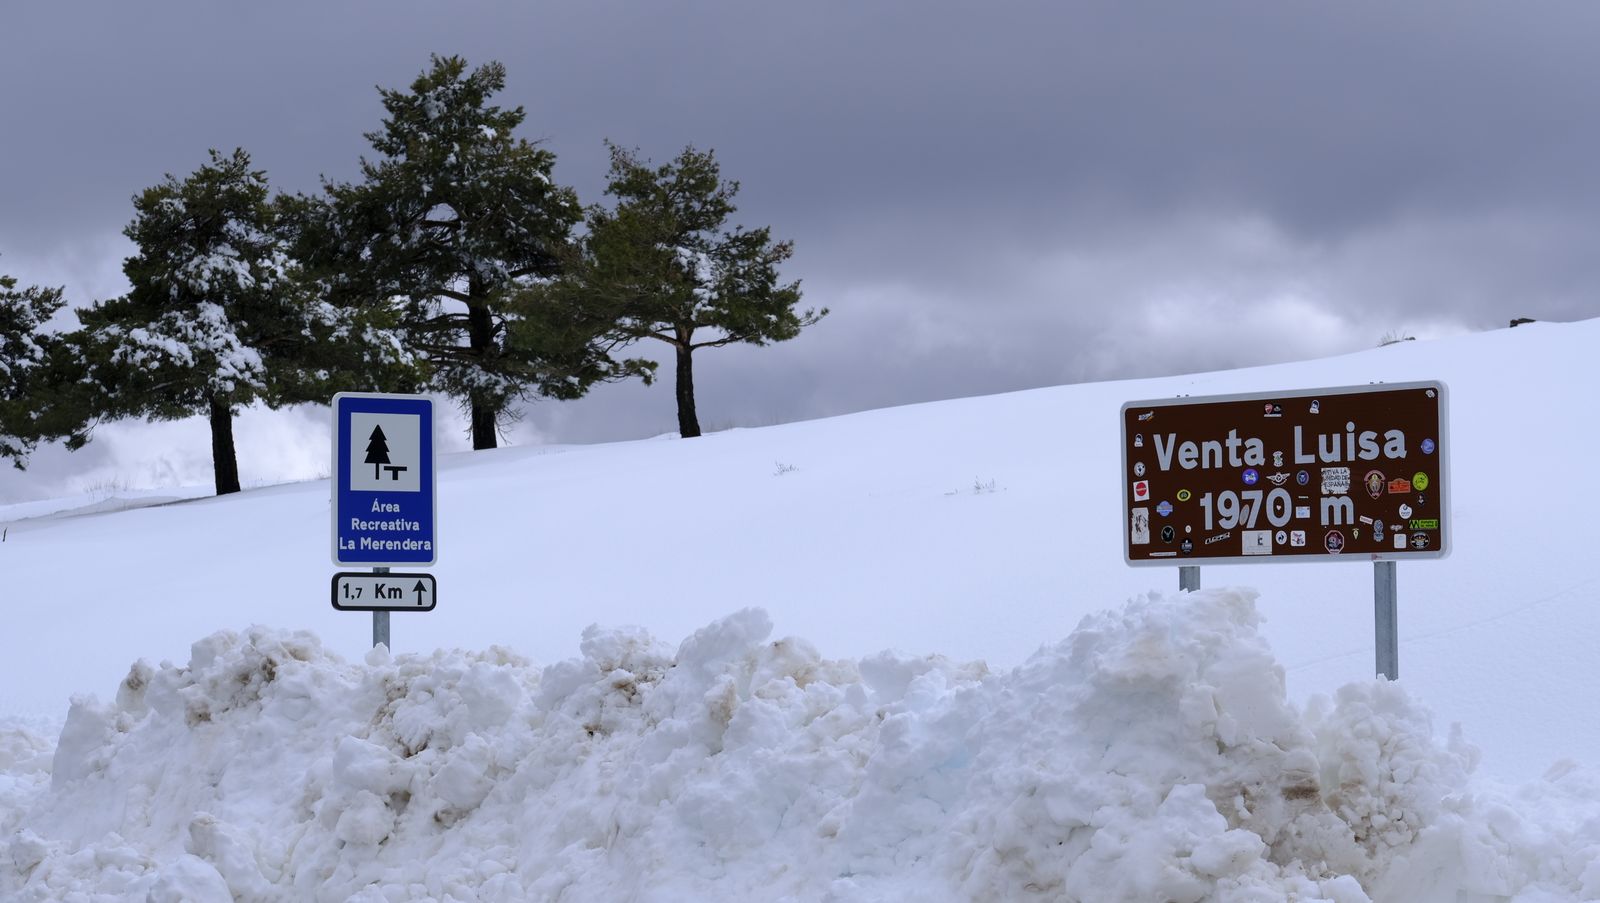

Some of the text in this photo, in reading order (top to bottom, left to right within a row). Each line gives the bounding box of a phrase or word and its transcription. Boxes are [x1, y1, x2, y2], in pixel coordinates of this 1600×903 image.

[1152, 421, 1408, 471] Venta Luisa
[371, 498, 400, 512] Área
[1200, 488, 1355, 531] 1970 m
[351, 518, 420, 532] Recreativa
[339, 537, 432, 551] La Merendera
[342, 583, 403, 600] 1,7 Km
